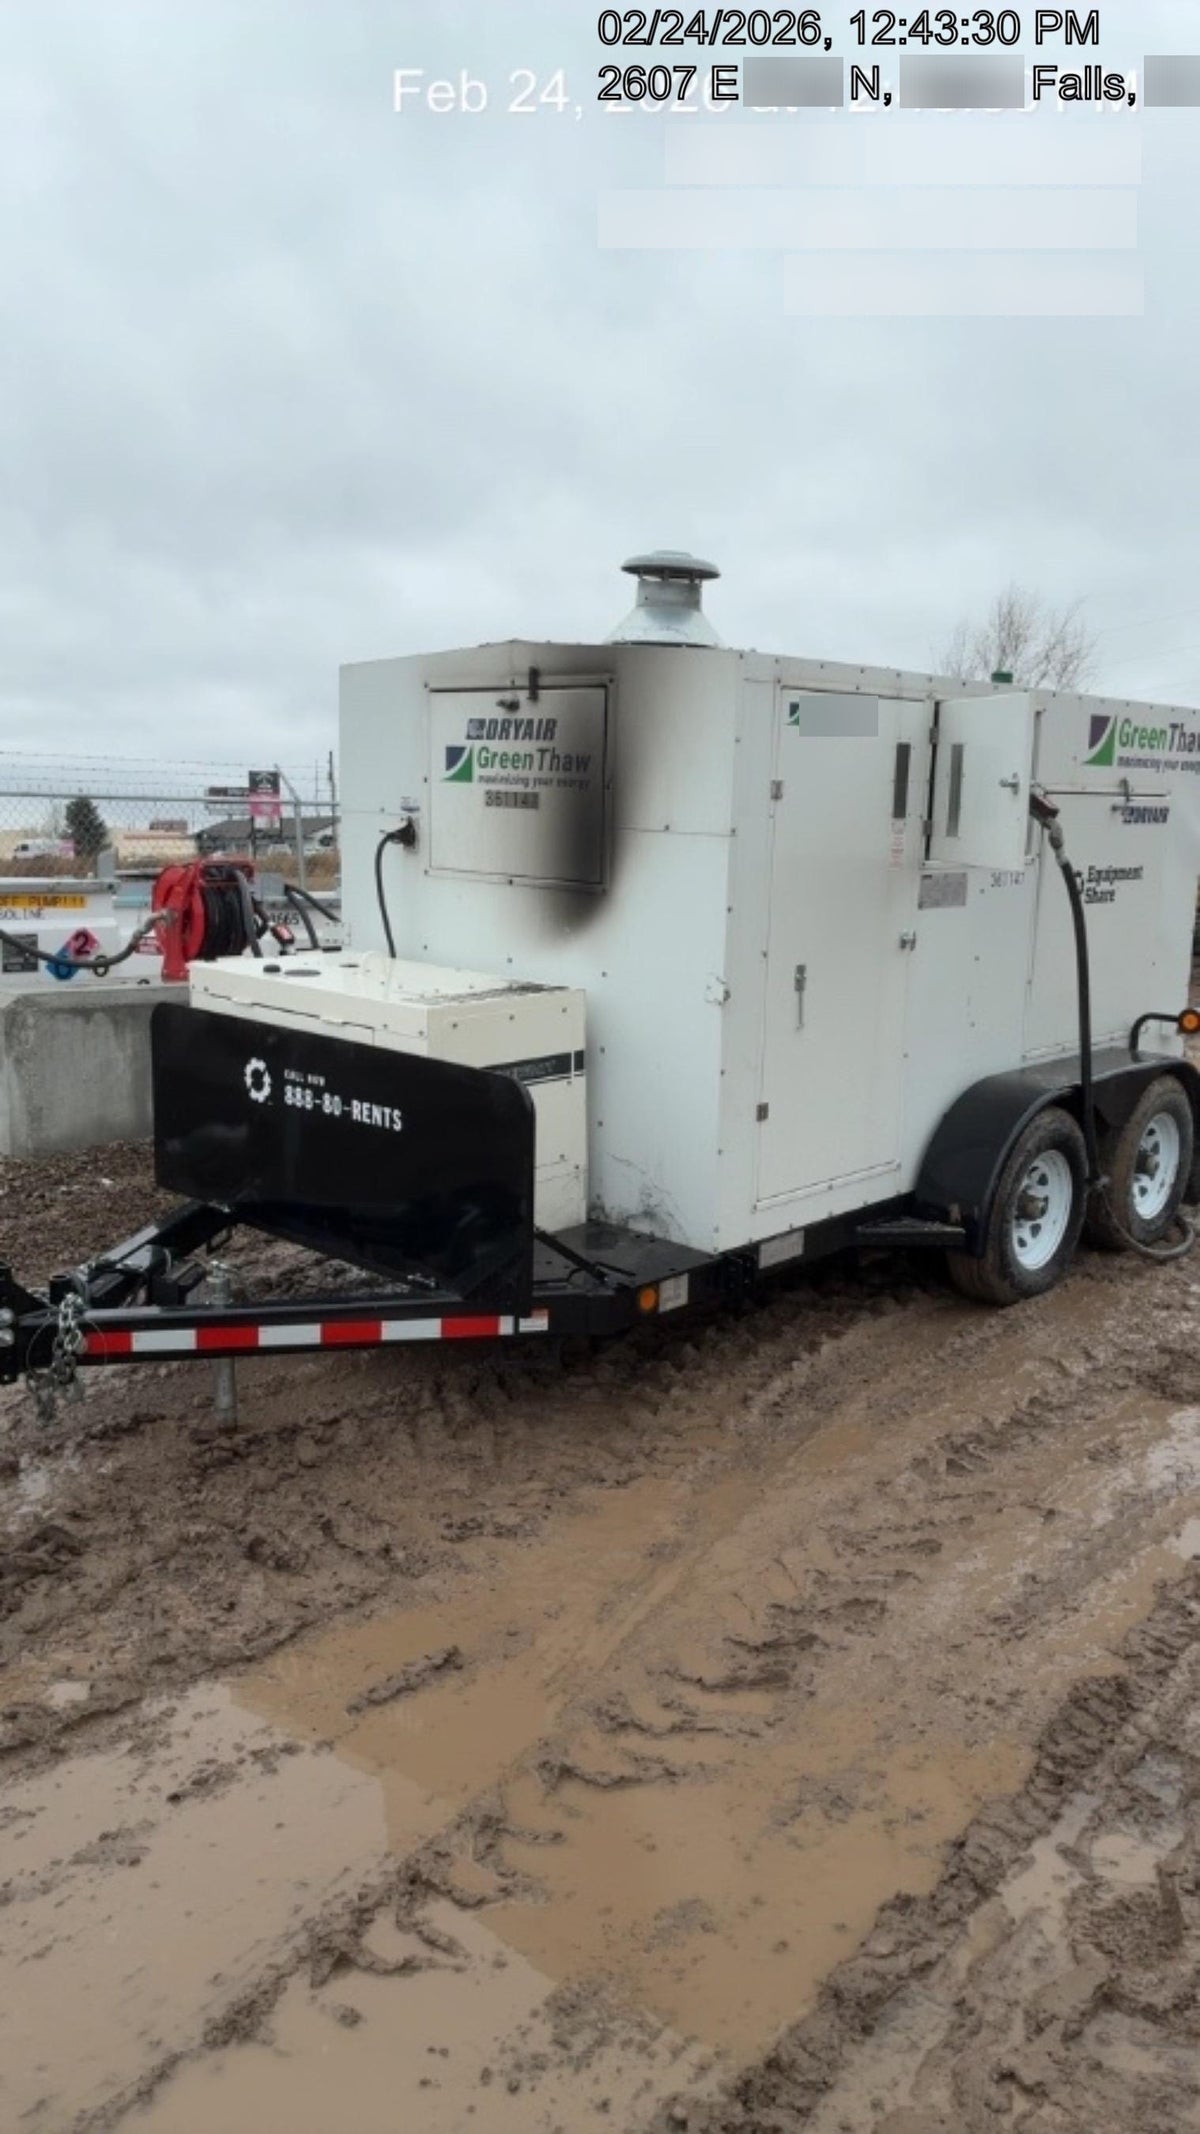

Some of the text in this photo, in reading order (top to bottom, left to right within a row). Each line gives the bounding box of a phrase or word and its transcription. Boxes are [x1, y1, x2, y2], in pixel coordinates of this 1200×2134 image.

[486, 718, 558, 741] DRYAIR
[1119, 717, 1200, 753] GreenTha
[477, 746, 591, 772] GreenThaw
[1087, 865, 1144, 885] Equipment
[1085, 889, 1116, 904] Share
[73, 930, 91, 956] 2
[284, 1085, 403, 1132] 888-80-RENTS
